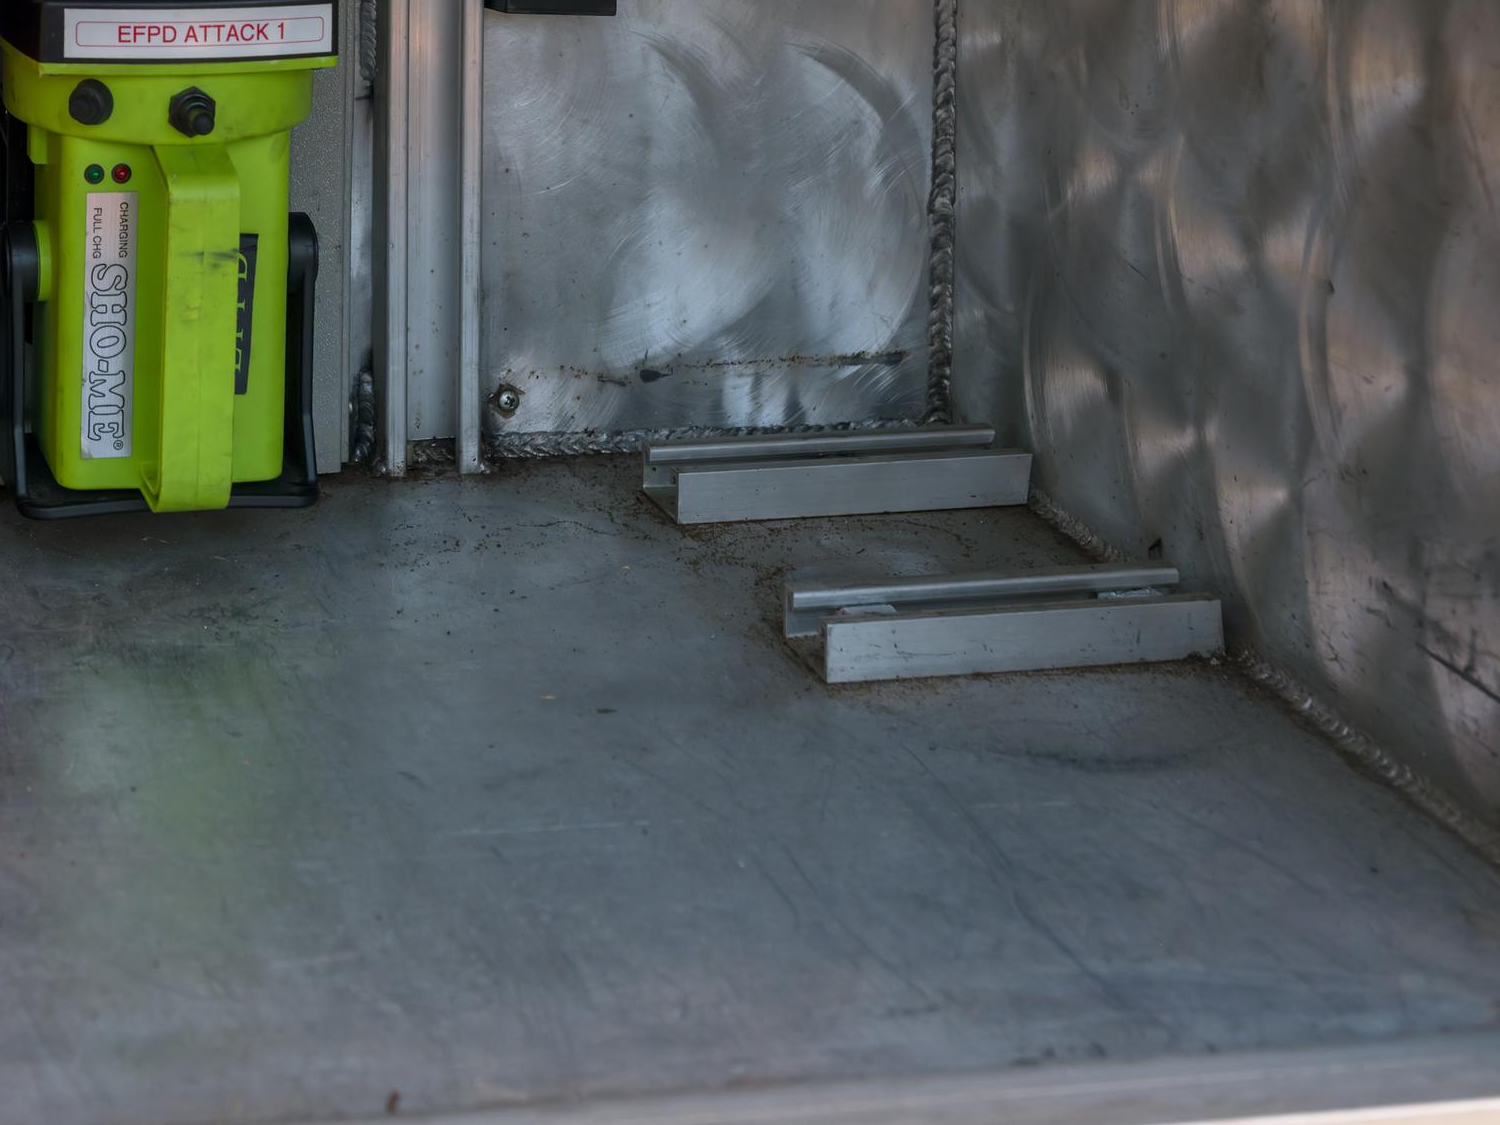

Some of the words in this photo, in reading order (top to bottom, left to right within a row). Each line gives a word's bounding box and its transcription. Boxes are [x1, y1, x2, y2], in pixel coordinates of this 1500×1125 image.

[117, 25, 177, 43] EFPD
[184, 23, 269, 43] ATTACK
[277, 22, 285, 40] 1
[93, 207, 102, 233] FULL
[119, 201, 129, 259] CHARGING
[92, 236, 102, 259] CHG
